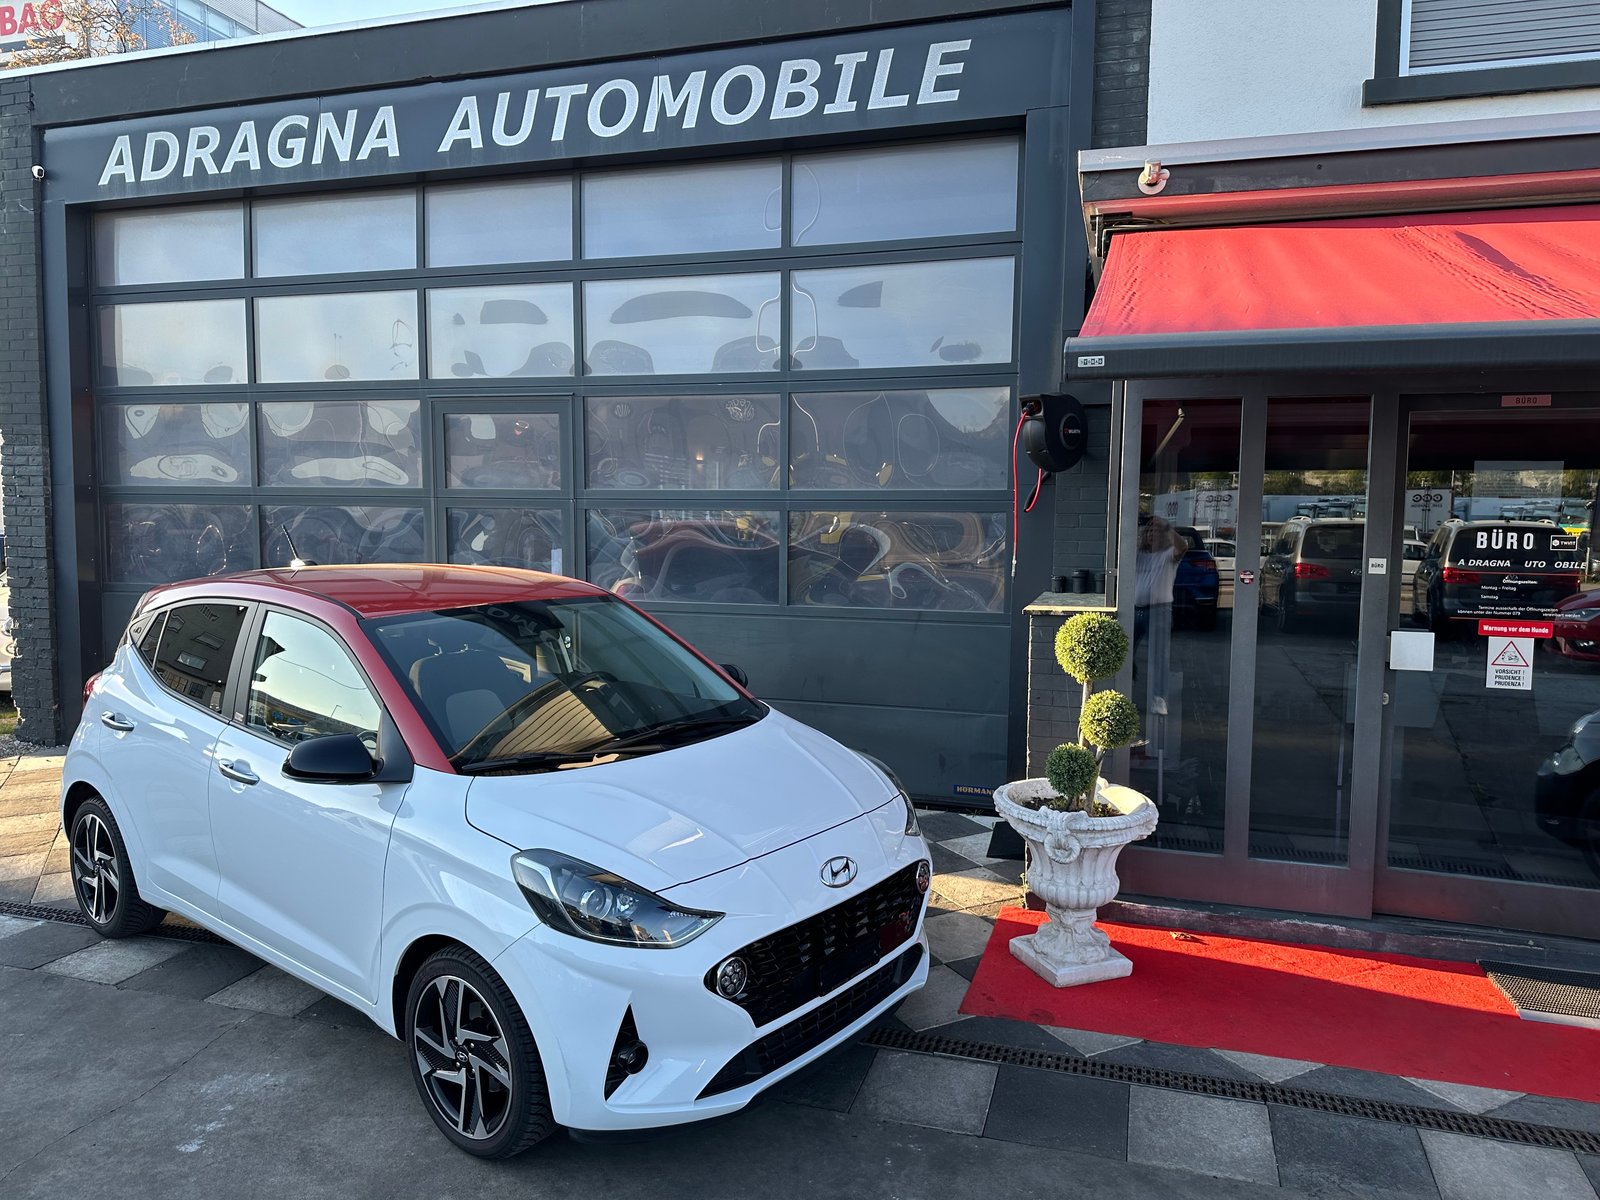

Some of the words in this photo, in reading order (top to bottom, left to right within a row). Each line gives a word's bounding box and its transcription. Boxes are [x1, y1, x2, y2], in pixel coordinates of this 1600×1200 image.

[98, 105, 400, 186] ADRAGNA
[437, 38, 972, 154] AUTOMOBILE
[1476, 529, 1534, 550] BÜRO
[1524, 560, 1546, 568] UTO
[1483, 625, 1508, 633] Warnung
[1531, 626, 1549, 634] Hunde
